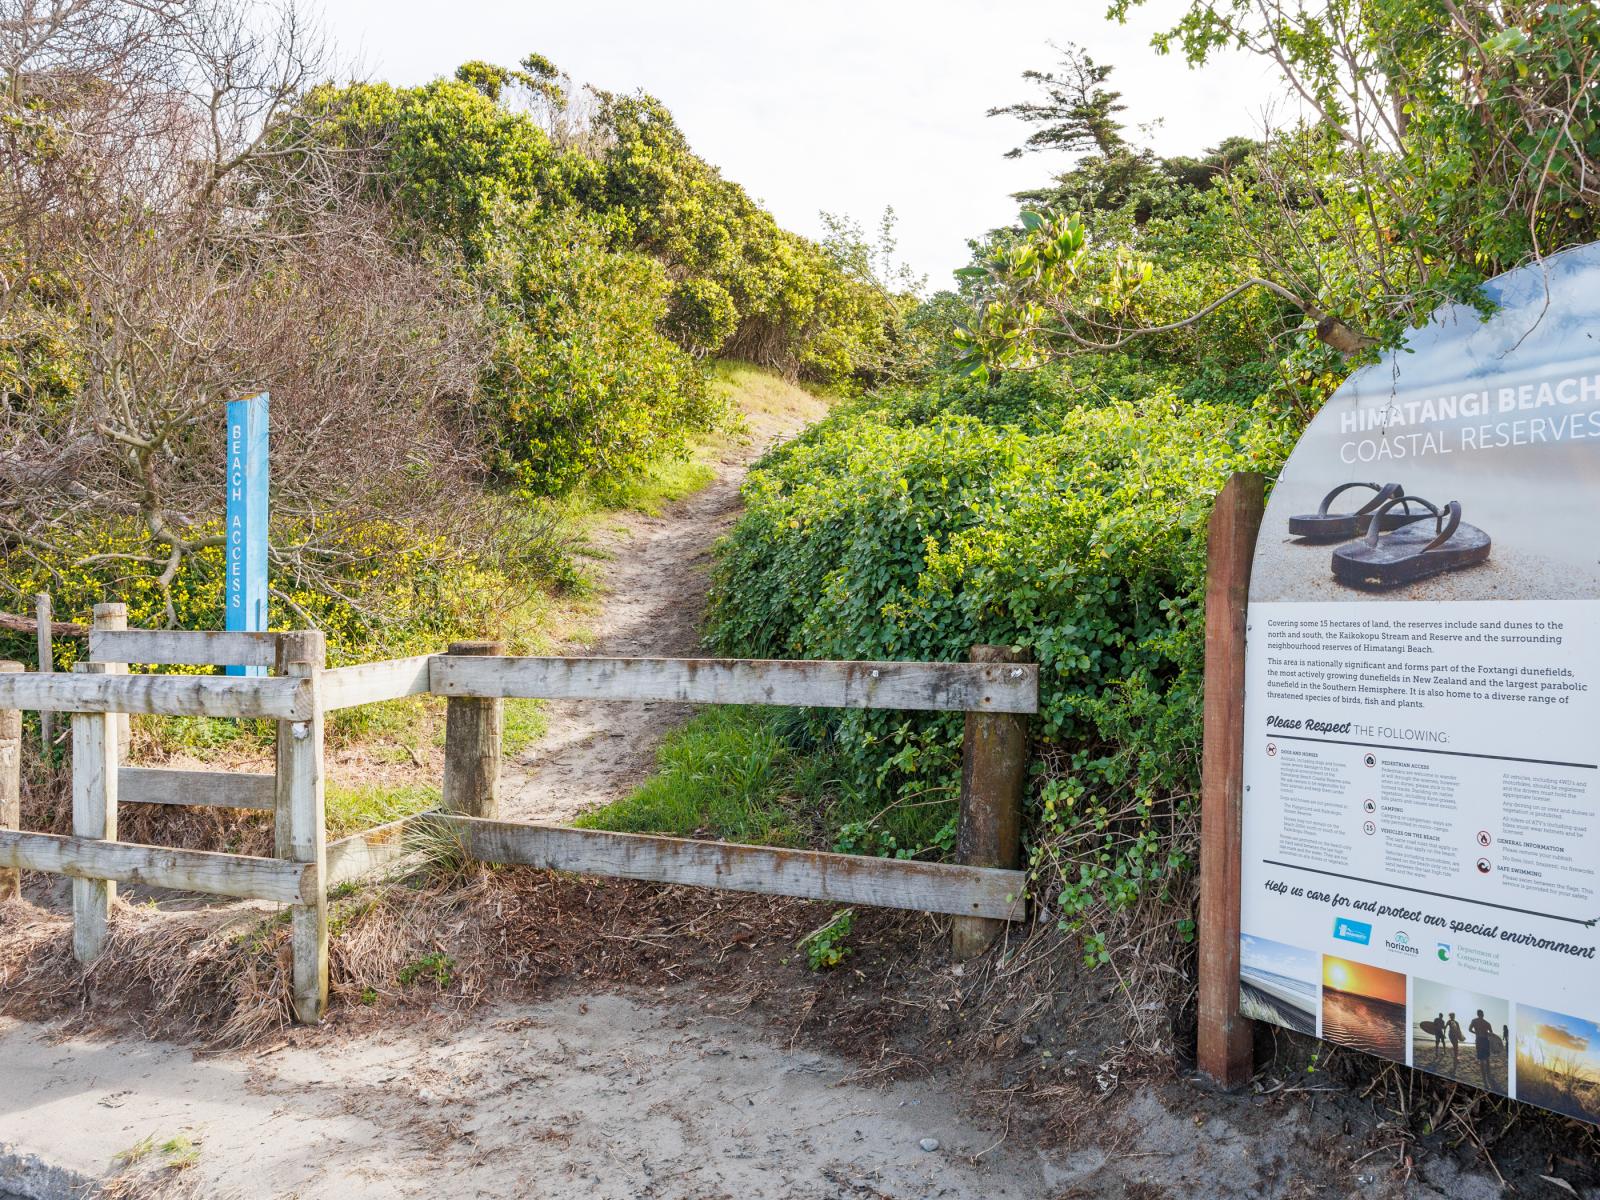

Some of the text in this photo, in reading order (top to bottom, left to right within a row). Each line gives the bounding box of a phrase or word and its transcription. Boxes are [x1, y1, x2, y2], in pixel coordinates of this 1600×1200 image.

[1340, 375, 1600, 434] HIMATANGI BEACH
[1340, 411, 1600, 464] COASTAL RESERVES
[232, 425, 241, 608] BEACH ACCESS
[1268, 620, 1298, 628] Covering
[1329, 619, 1360, 628] hectares
[1372, 620, 1391, 628] land,
[1393, 620, 1406, 628] the
[1445, 620, 1477, 628] include
[1480, 621, 1501, 629] sand
[1504, 621, 1532, 630] dunes
[1547, 621, 1563, 630] the
[1339, 632, 1380, 641] Kaikokopu
[1381, 632, 1410, 640] Stream
[1429, 633, 1462, 641] Reserve
[1464, 634, 1482, 642] and
[1484, 634, 1498, 642] the
[1500, 634, 1562, 644] surrounding
[1268, 642, 1320, 650] neighbourhood
[1353, 643, 1362, 652] of
[1364, 644, 1405, 654] Himatangi
[1407, 644, 1434, 653] Beach.
[1307, 660, 1343, 669] nationally
[1344, 661, 1386, 670] significant
[1404, 662, 1428, 671] forms
[1431, 665, 1448, 673] part
[1460, 665, 1475, 673] the
[1478, 665, 1518, 676] Foxtangi
[1520, 667, 1575, 677] dunefields,
[1297, 671, 1325, 680] actively
[1327, 672, 1358, 682] growing
[1359, 673, 1400, 682] dunefields
[1402, 675, 1411, 683] in
[1413, 675, 1431, 684] New
[1433, 676, 1467, 686] Zealand
[1470, 678, 1486, 686] and
[1489, 678, 1504, 687] the
[1506, 680, 1538, 689] largest
[1541, 682, 1588, 691] parabolic
[1267, 680, 1299, 688] dunefield
[1322, 682, 1357, 692] Southern
[1358, 684, 1408, 695] Hemisphere.
[1410, 688, 1416, 696] It
[1418, 688, 1426, 696] is
[1427, 688, 1444, 696] also
[1446, 689, 1471, 698] home
[1491, 692, 1526, 702] diverse
[1528, 696, 1556, 704] range
[1558, 696, 1569, 704] of
[1267, 691, 1303, 700] threatened
[1341, 696, 1363, 704] birds,
[1364, 697, 1379, 705] fish
[1398, 699, 1424, 708] plants.
[1266, 716, 1450, 743] Please Respect THE FOLLOWING:
[1381, 828, 1403, 836] VEHICLES
[1497, 838, 1564, 852] GENERAL INFORMATION
[1511, 868, 1542, 877] SWIMMING
[1264, 880, 1596, 959] Help us care for and protect our special environment
[1386, 940, 1419, 954] horizons
[1458, 945, 1492, 958] Department
[1457, 953, 1500, 968] Conservation
